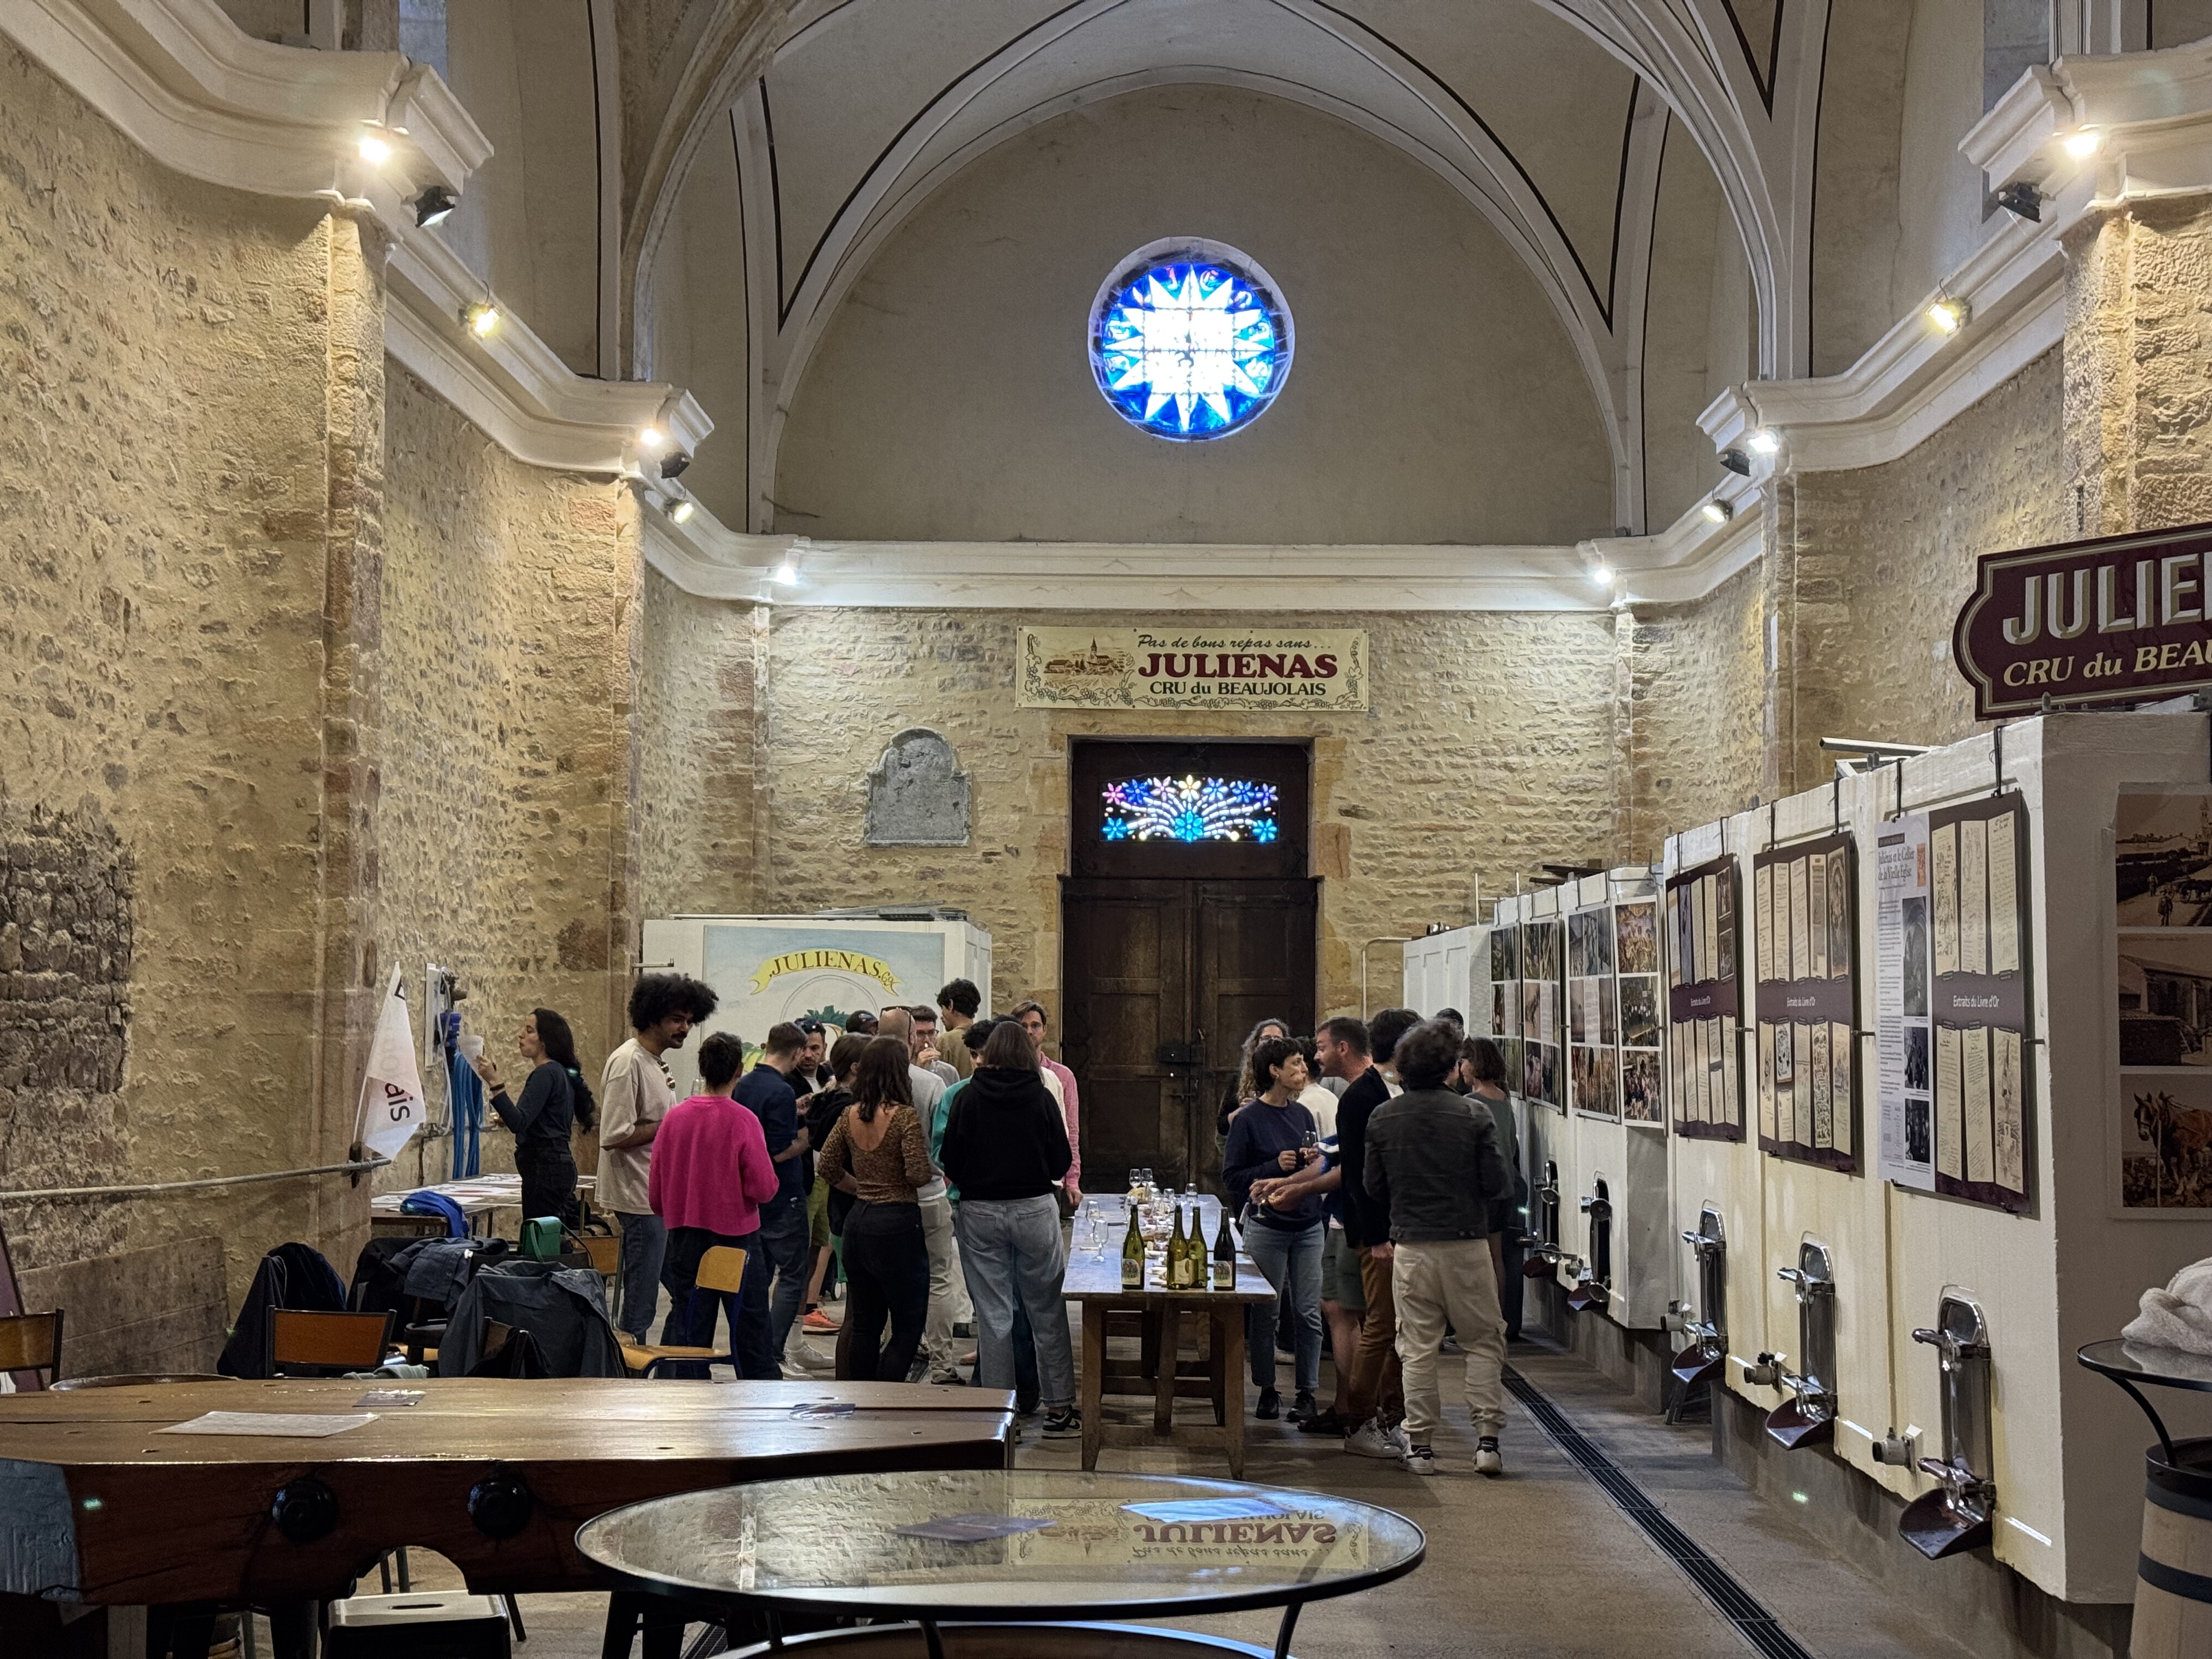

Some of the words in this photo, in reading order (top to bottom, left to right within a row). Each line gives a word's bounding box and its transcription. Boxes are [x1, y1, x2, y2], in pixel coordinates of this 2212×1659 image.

[1137, 634, 1167, 648] Pas
[1171, 635, 1190, 648] de
[1192, 635, 1226, 649] bons
[1229, 639, 1273, 652] repas
[1138, 653, 1338, 679] JULIENAS
[2004, 656, 2075, 687] CRU
[2083, 652, 2123, 678] du
[1150, 681, 1187, 695] CRU
[1190, 681, 1211, 695] du
[1217, 682, 1327, 696] BEAUJOLAIS
[1953, 995, 1971, 1007] Extraits
[1971, 995, 1977, 1007] du
[1977, 995, 1988, 1008] Livre
